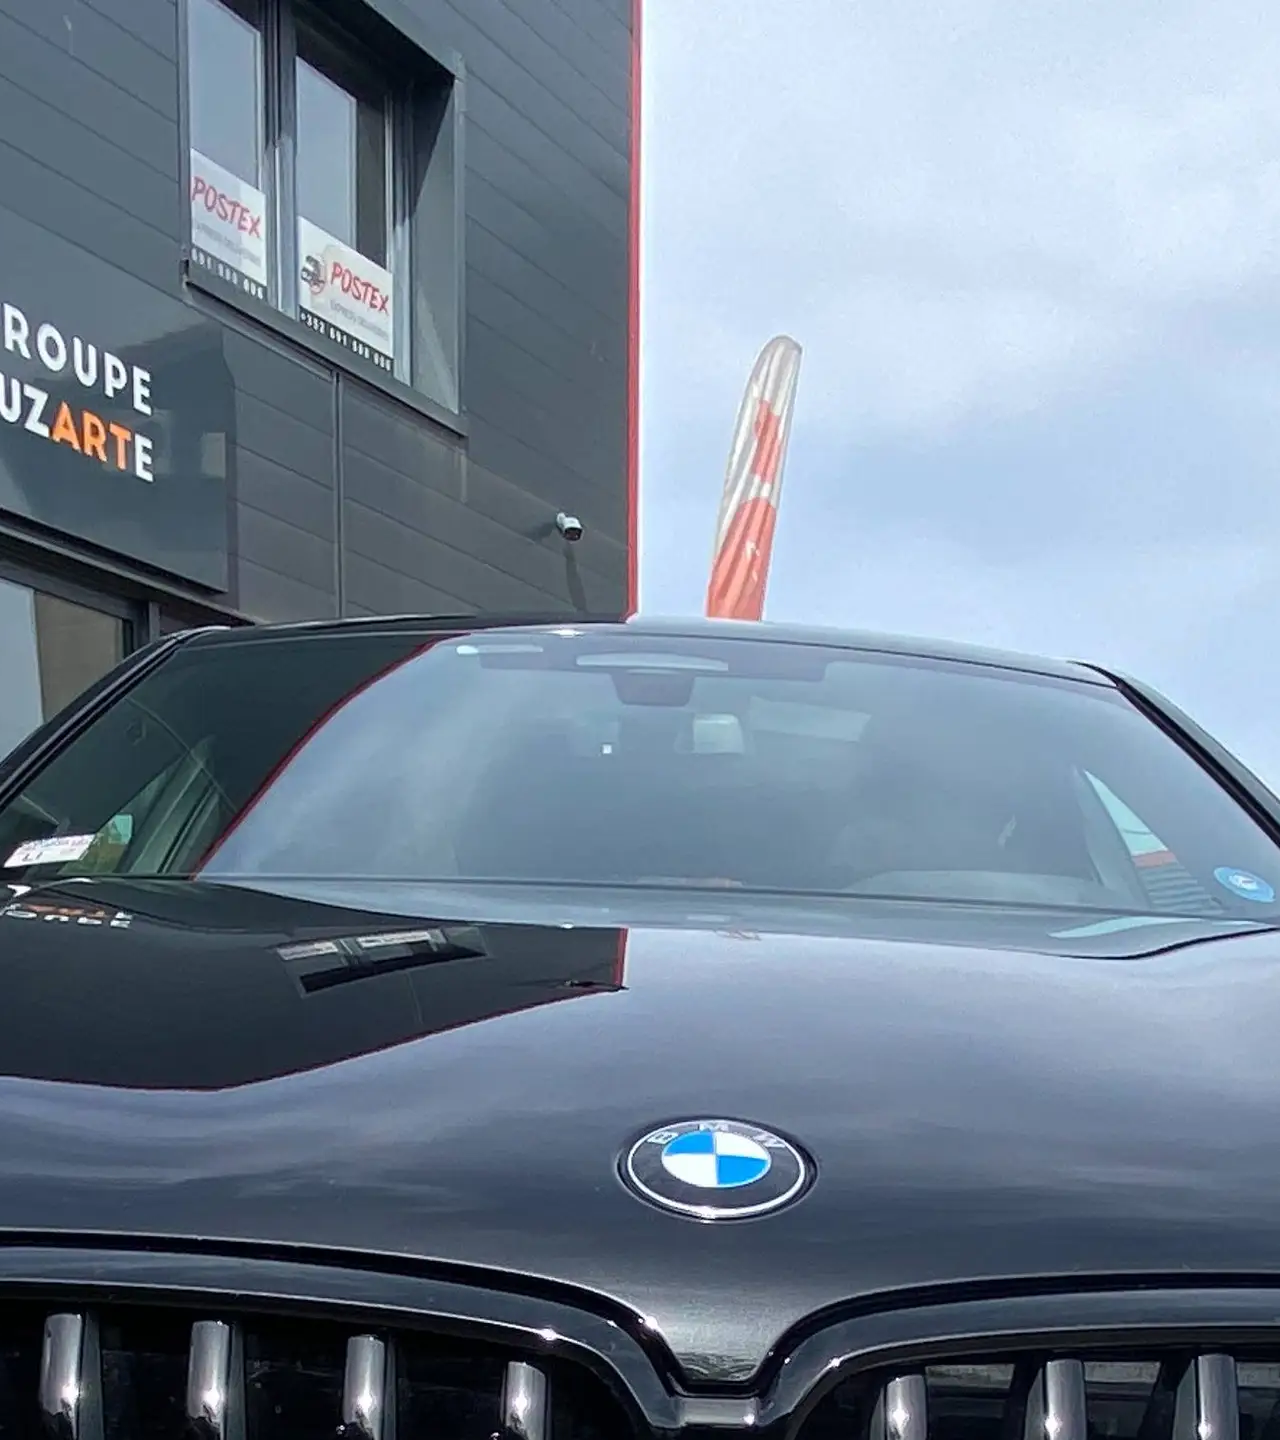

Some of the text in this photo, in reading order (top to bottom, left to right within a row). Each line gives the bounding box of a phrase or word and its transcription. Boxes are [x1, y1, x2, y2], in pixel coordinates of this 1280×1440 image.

[192, 176, 262, 239] POSTEX
[331, 262, 390, 316] POSTEX
[646, 1122, 787, 1149] BMW
